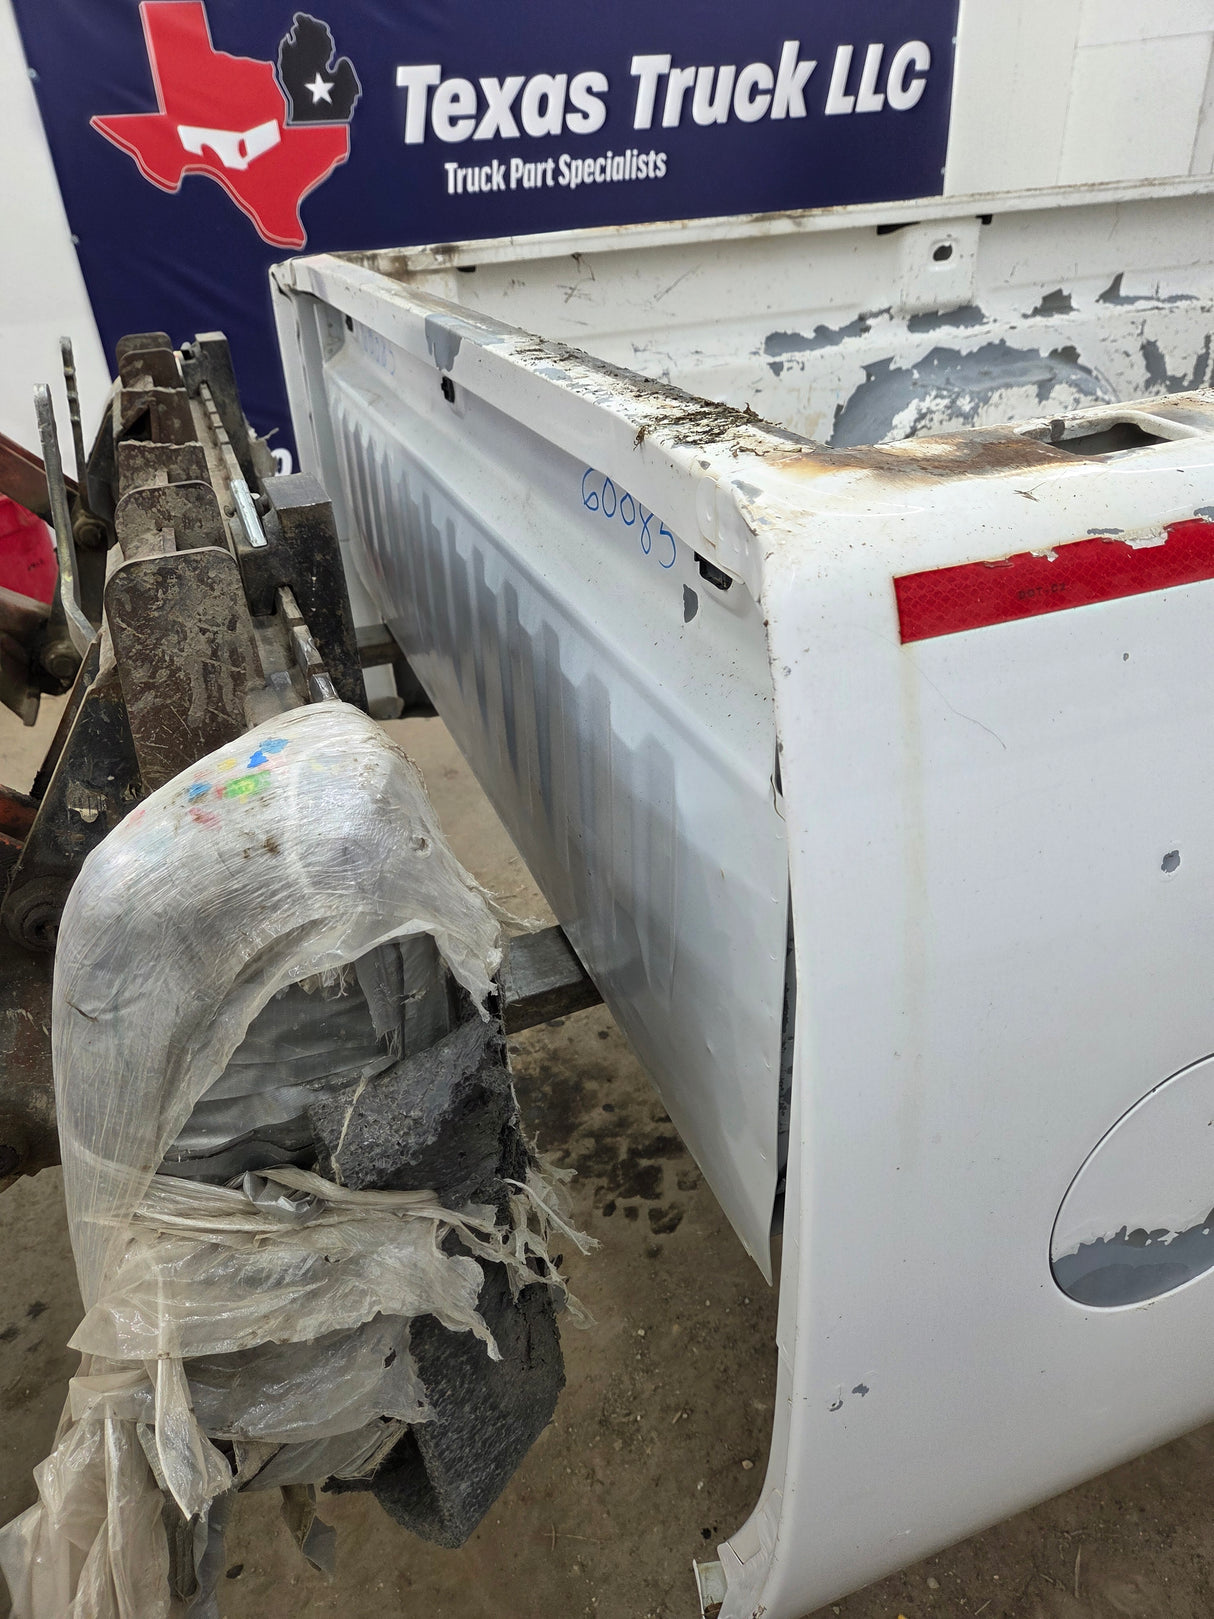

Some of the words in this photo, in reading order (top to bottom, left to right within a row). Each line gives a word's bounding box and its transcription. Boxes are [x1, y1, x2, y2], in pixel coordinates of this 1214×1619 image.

[396, 64, 609, 145] Texas
[630, 40, 818, 130] Truck
[824, 40, 931, 116] LLC
[444, 159, 507, 195] Truck
[509, 157, 556, 190] Part
[558, 148, 668, 190] Specialists
[581, 467, 677, 569] 60085
